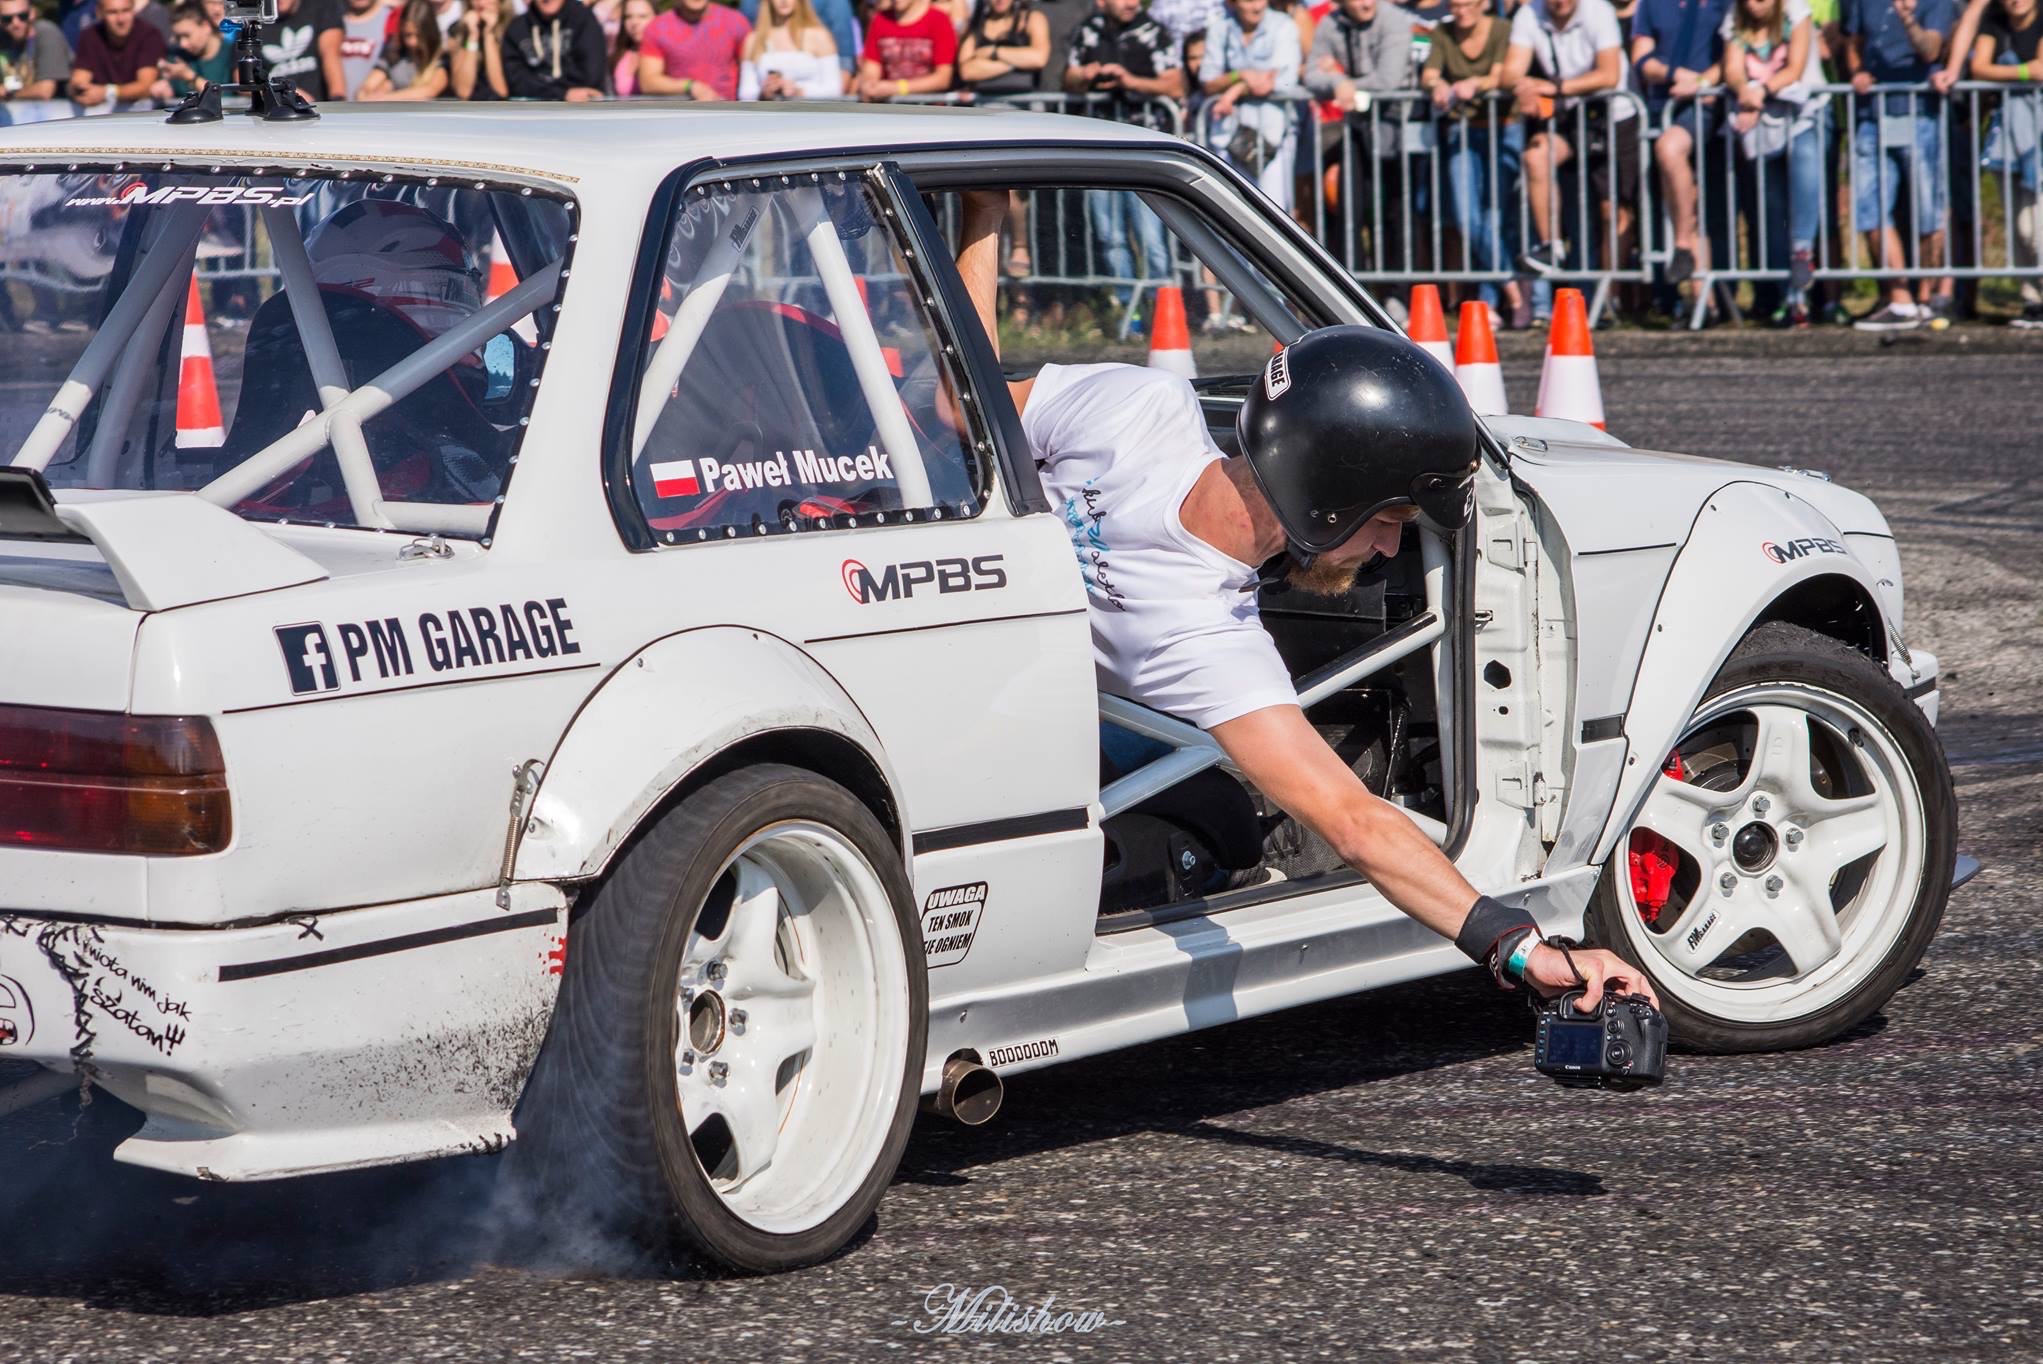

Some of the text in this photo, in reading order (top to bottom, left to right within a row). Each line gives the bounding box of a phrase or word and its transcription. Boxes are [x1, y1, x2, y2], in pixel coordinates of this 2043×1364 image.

[699, 446, 894, 493] Paweł Mucek
[1772, 538, 1847, 564] MPBS
[856, 554, 1007, 604] MPBS
[336, 617, 414, 682] PM
[418, 597, 581, 672] GARAGE
[927, 885, 986, 910] UWAGA
[928, 909, 974, 933] TEN SMOK
[935, 932, 973, 953] OGNIEM
[131, 975, 156, 1001] nim
[157, 993, 192, 1022] jak
[989, 1039, 1059, 1066] BOOOOOOM
